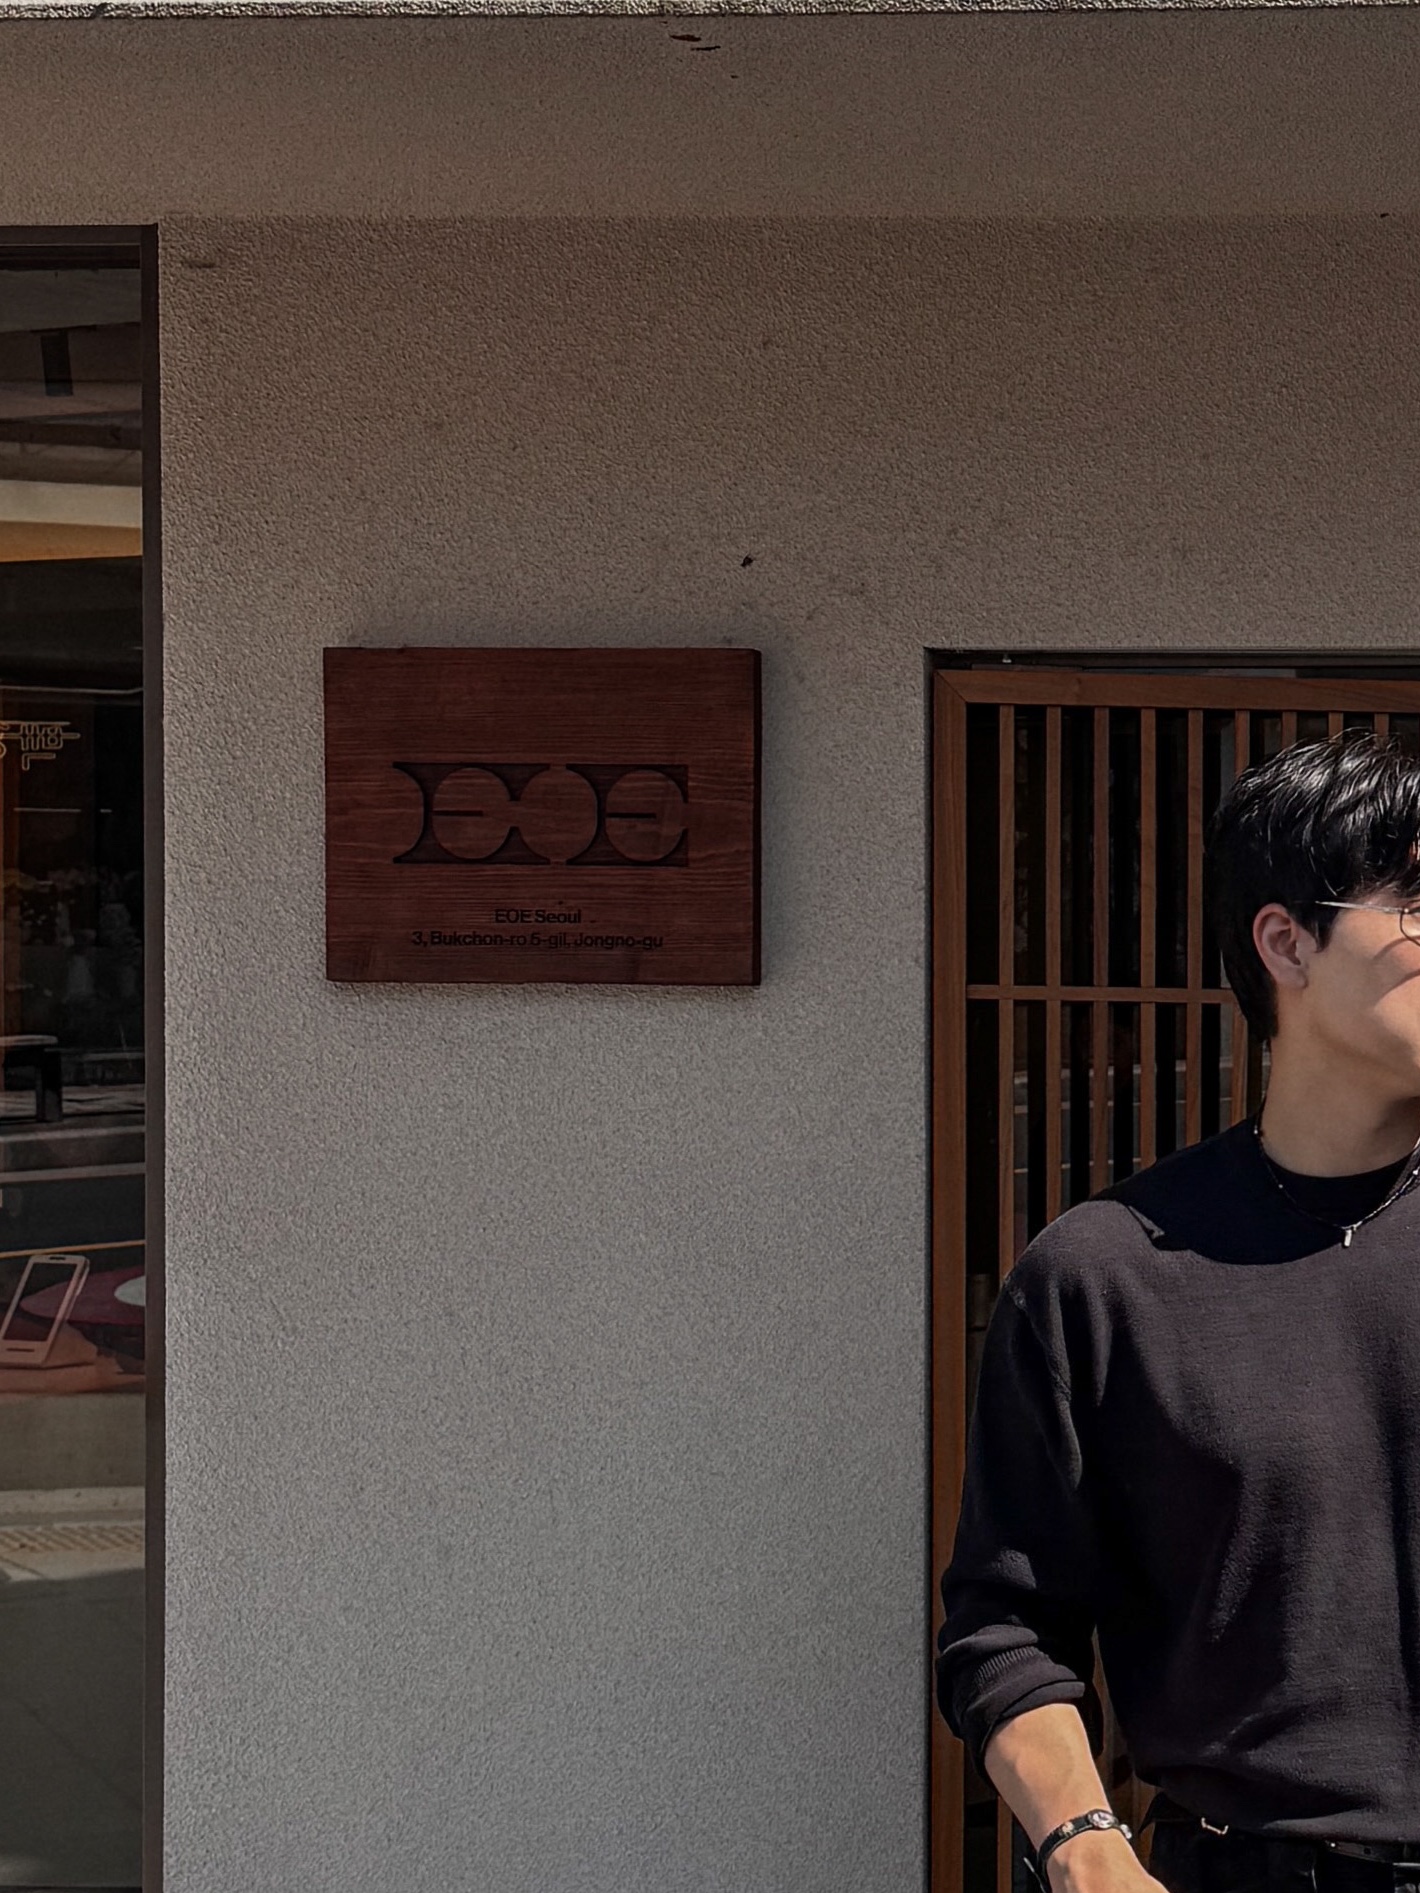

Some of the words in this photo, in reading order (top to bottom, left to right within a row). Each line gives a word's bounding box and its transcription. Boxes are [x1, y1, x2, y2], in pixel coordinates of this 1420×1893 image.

[495, 908, 533, 924] EOE
[534, 908, 582, 924] Seoul
[411, 930, 428, 947] 3,
[430, 930, 527, 946] Bukchon-ro
[574, 932, 664, 950] Jongno-gu
